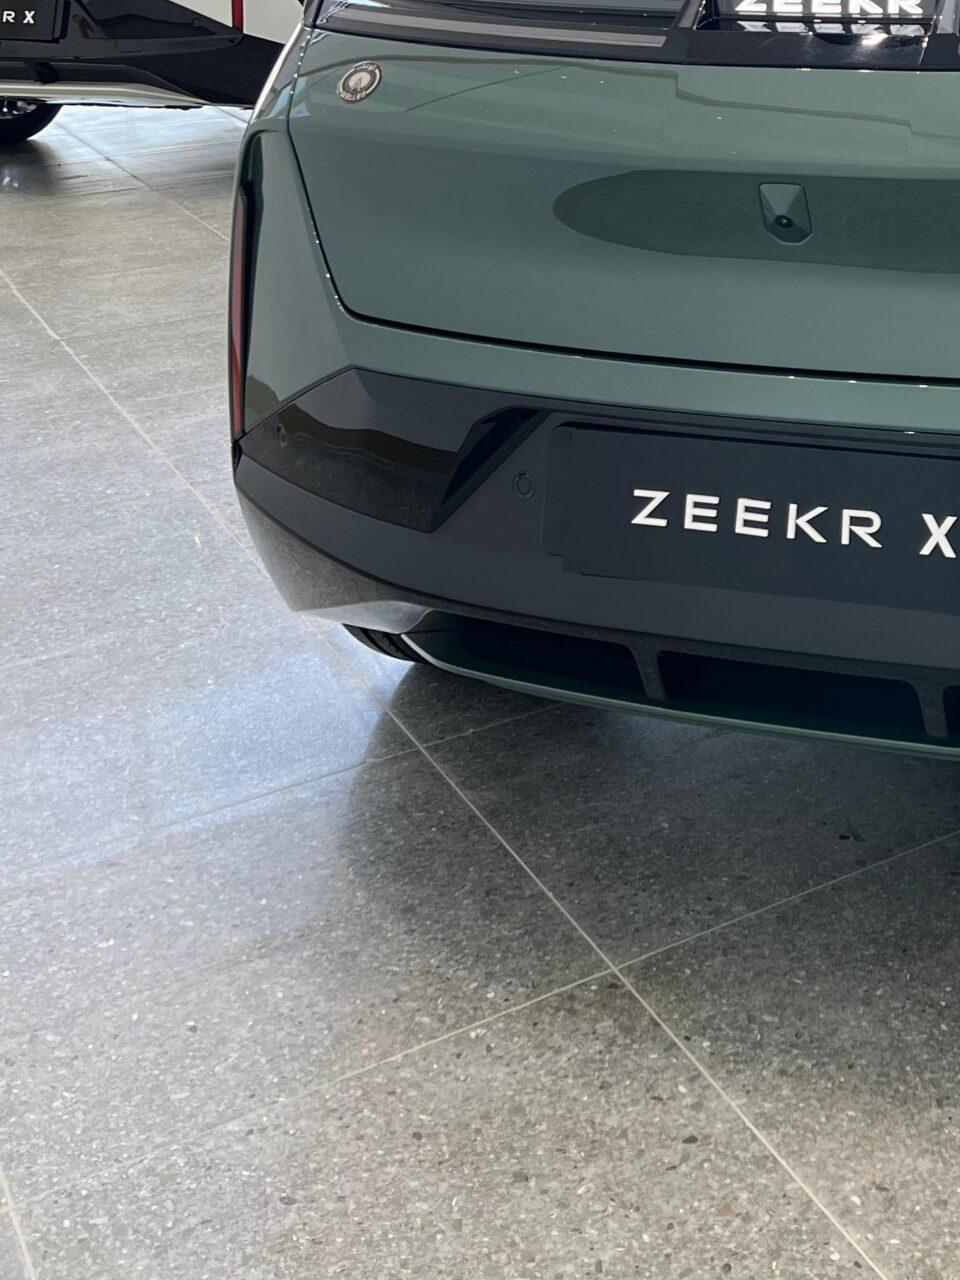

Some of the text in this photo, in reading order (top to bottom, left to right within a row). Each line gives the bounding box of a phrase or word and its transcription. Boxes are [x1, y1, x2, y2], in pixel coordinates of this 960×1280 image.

[22, 10, 36, 24] X
[631, 488, 958, 559] ZEEKR X
